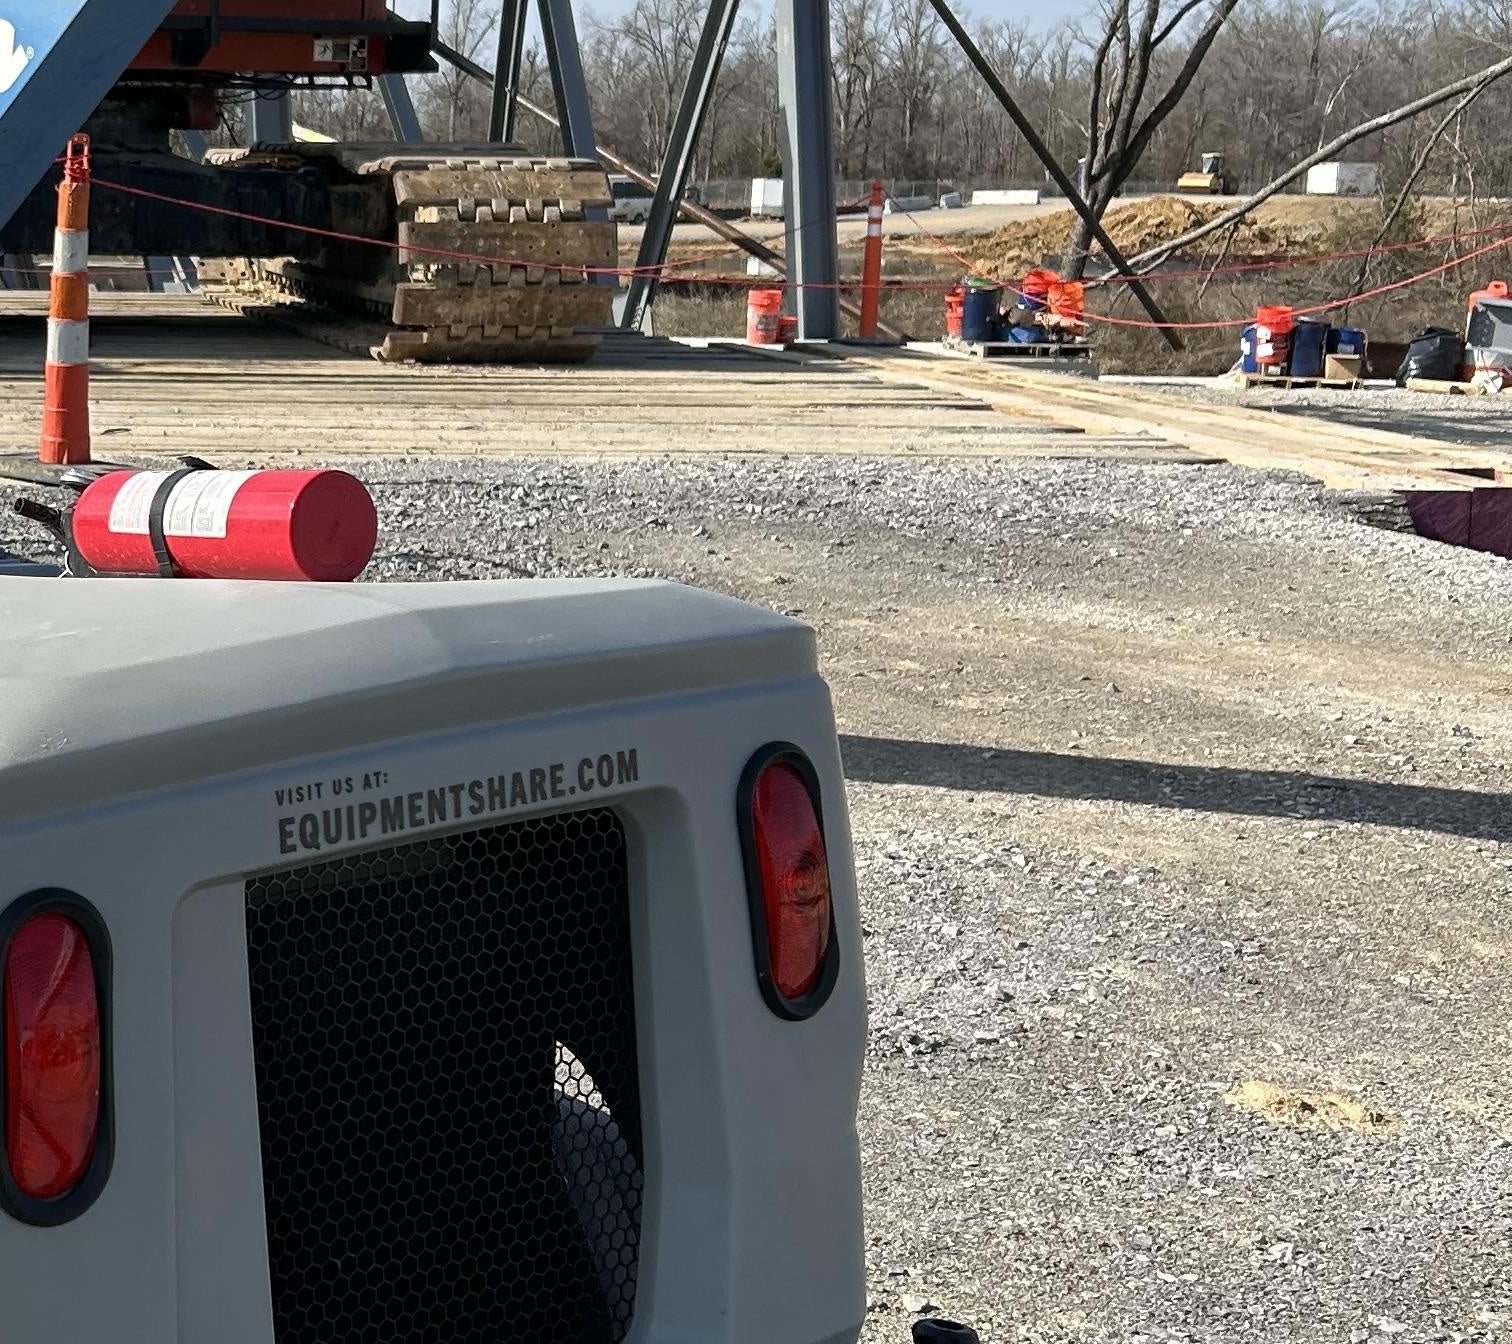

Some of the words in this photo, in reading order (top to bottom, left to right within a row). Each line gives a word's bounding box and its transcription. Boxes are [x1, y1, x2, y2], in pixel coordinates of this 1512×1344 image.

[275, 782, 323, 806] VISIT
[333, 777, 354, 796] US
[363, 770, 388, 790] AT:
[278, 748, 640, 855] EQUIPMENTSHARE.COM
